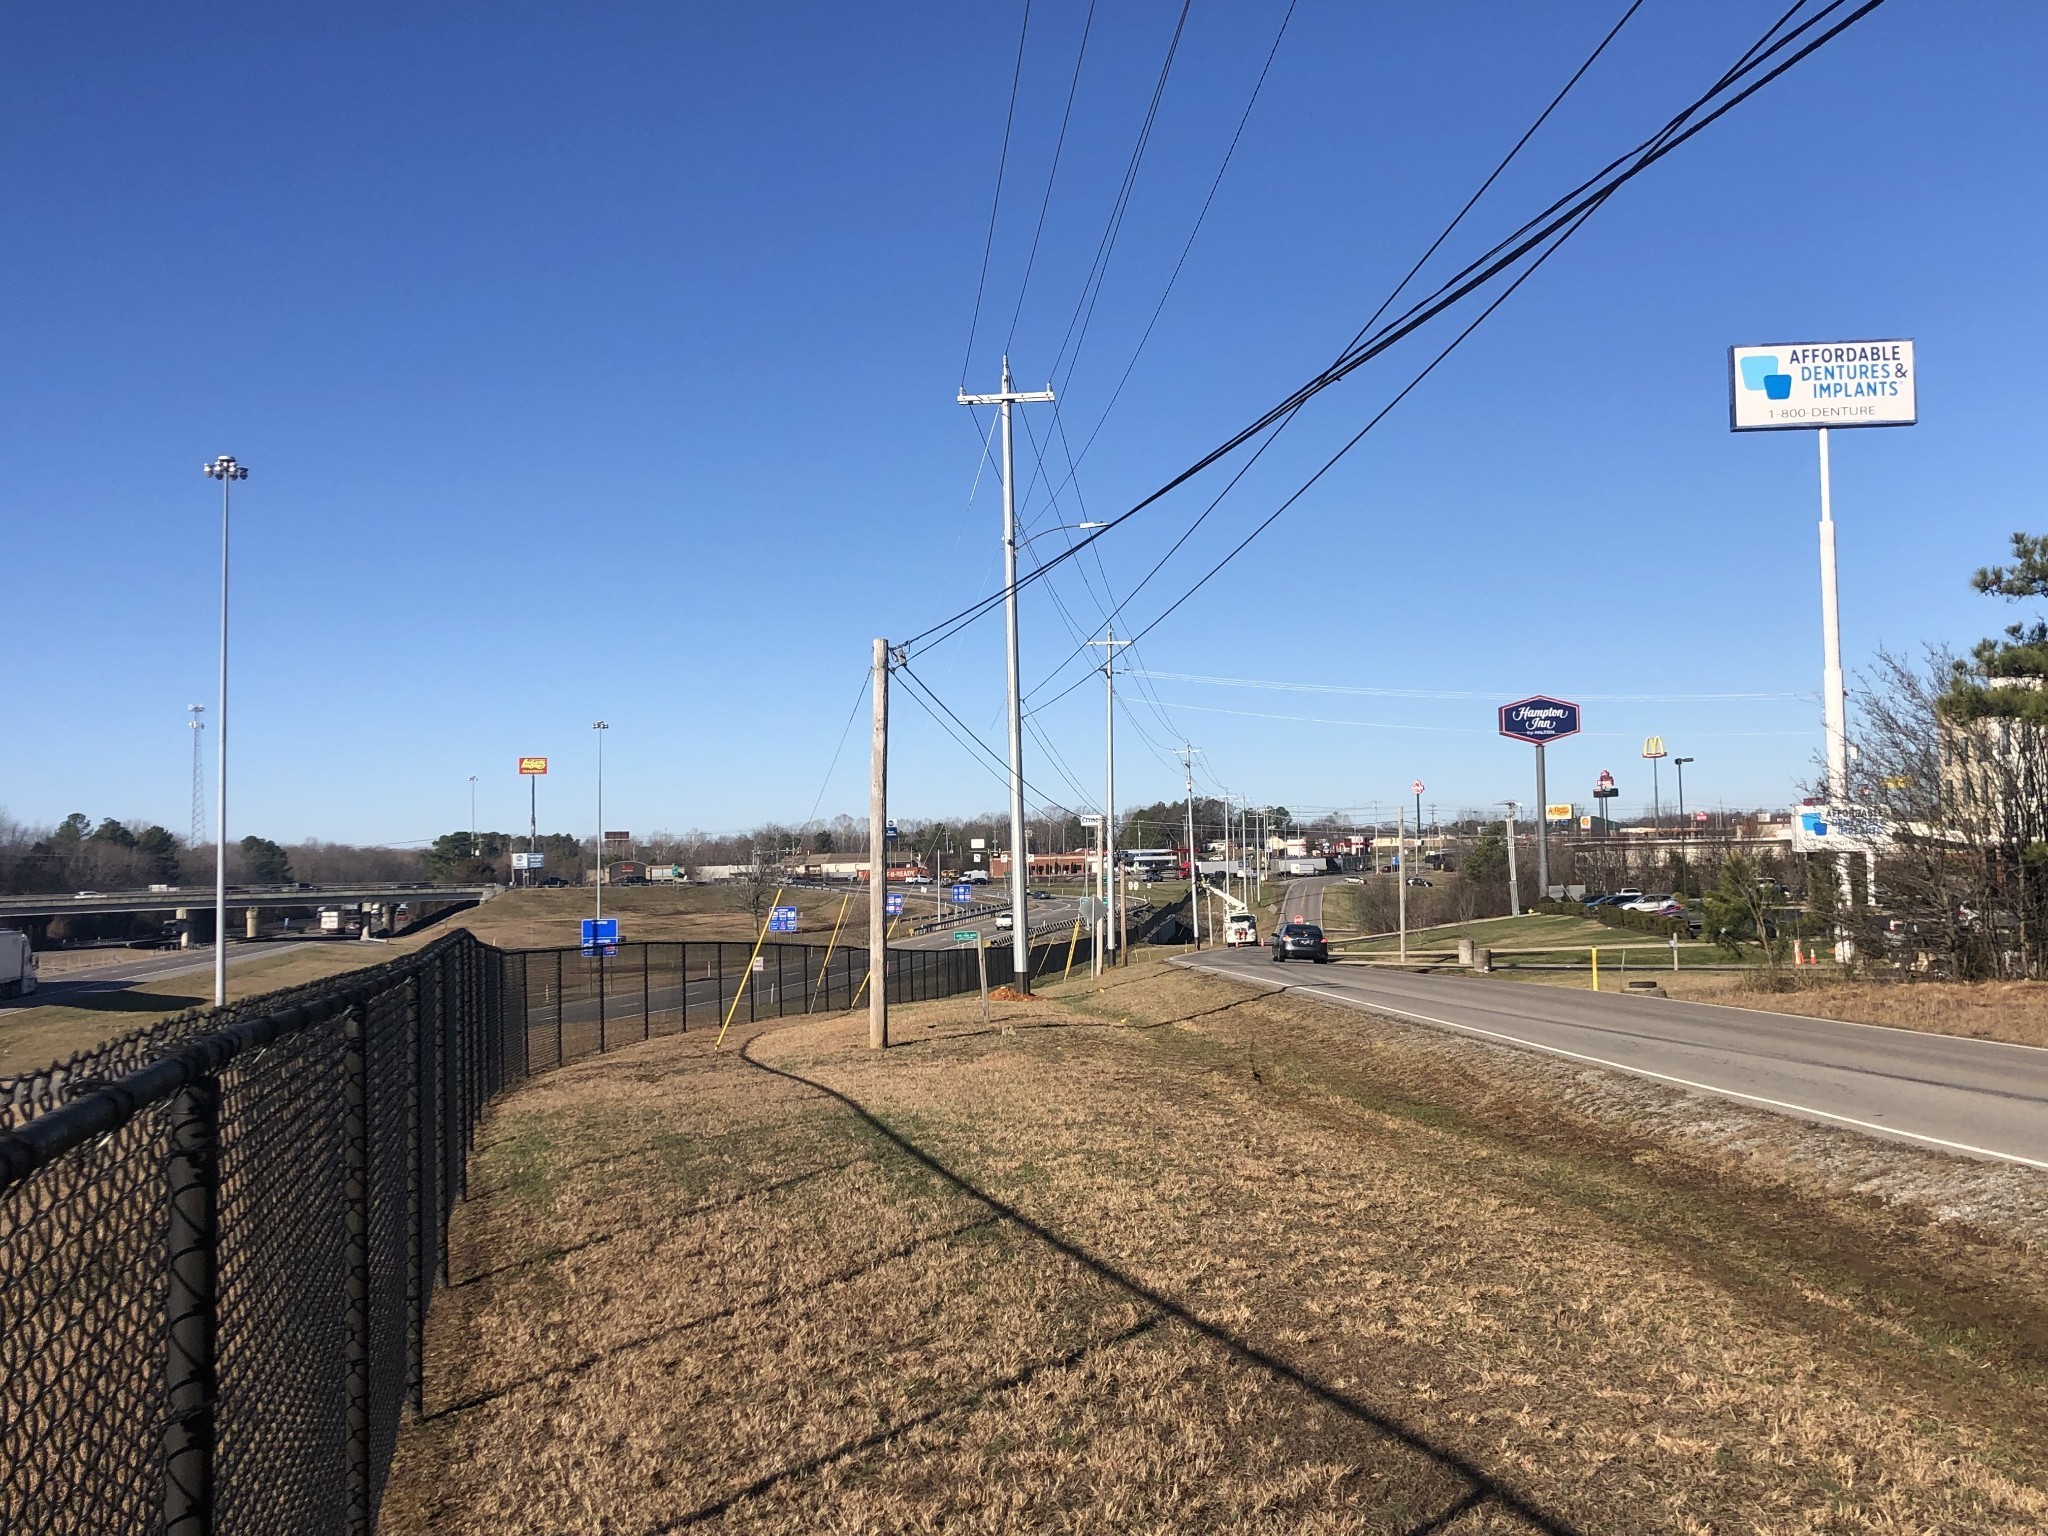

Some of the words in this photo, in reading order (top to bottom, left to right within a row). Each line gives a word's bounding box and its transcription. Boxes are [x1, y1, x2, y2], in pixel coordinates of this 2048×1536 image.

[1789, 345, 1901, 364] AFFORDABLE
[1801, 363, 1890, 381] DENTURES
[1895, 363, 1908, 379] &
[1813, 381, 1898, 398] IMPLANTS
[1768, 406, 1876, 419] 1-800-DENTURE
[1512, 706, 1568, 721] Hampton
[1526, 718, 1556, 730] Inn
